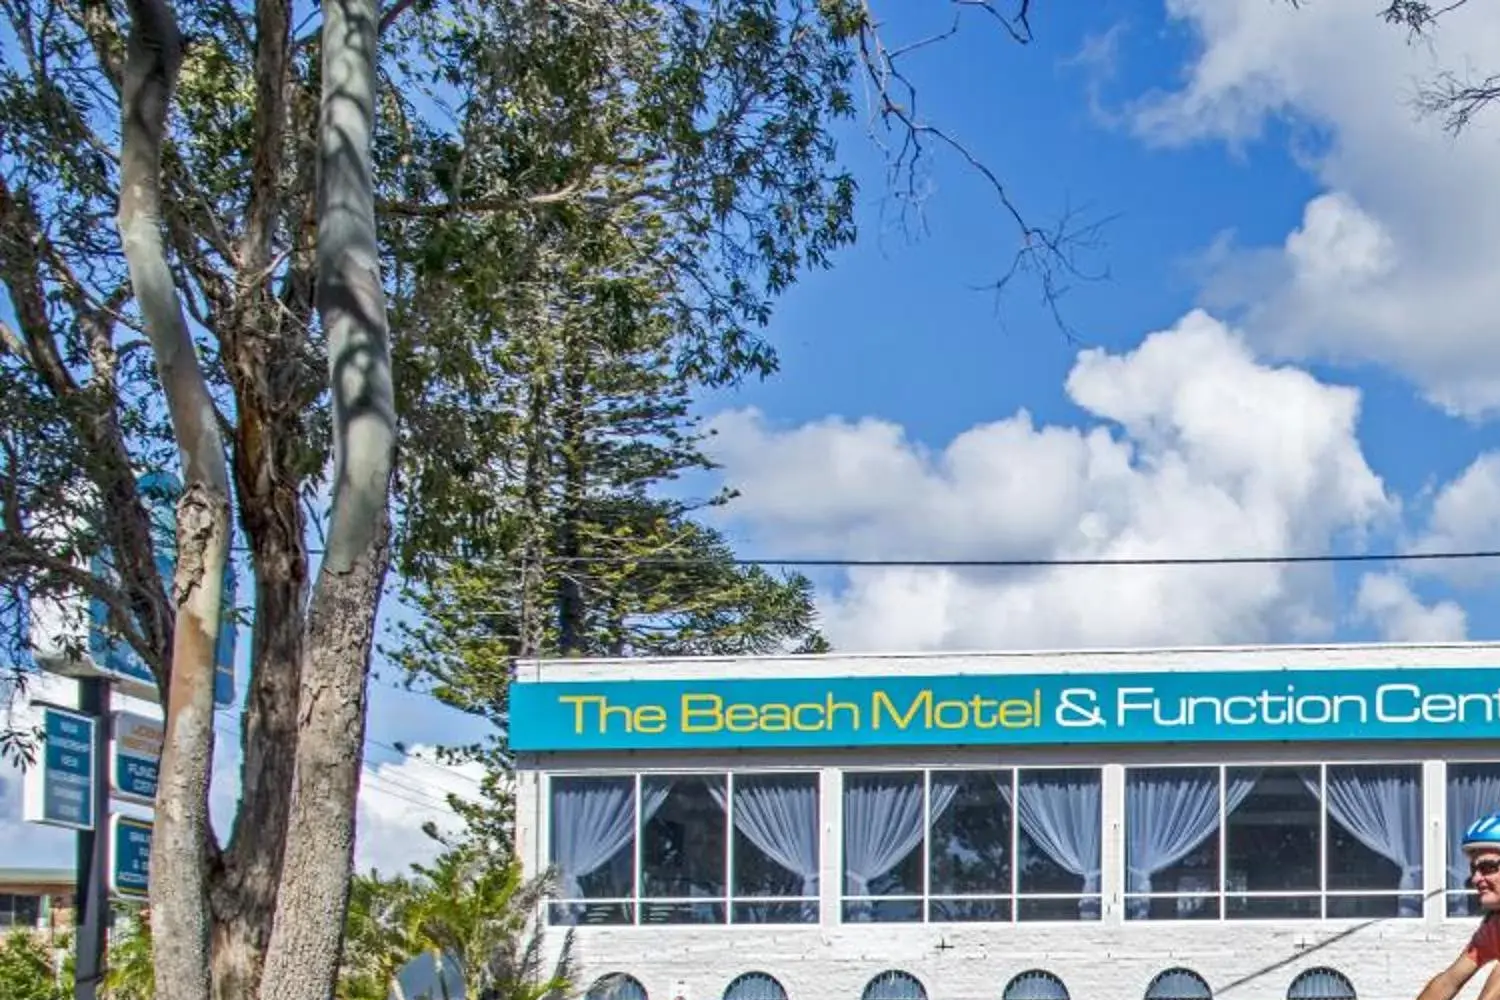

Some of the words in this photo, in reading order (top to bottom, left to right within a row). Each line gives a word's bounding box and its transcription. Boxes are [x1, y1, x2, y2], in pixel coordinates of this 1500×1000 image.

[559, 694, 667, 734] The
[681, 691, 860, 732] Beach
[871, 688, 1042, 731] Motel
[1055, 687, 1106, 728] &
[1116, 684, 1368, 727] Function
